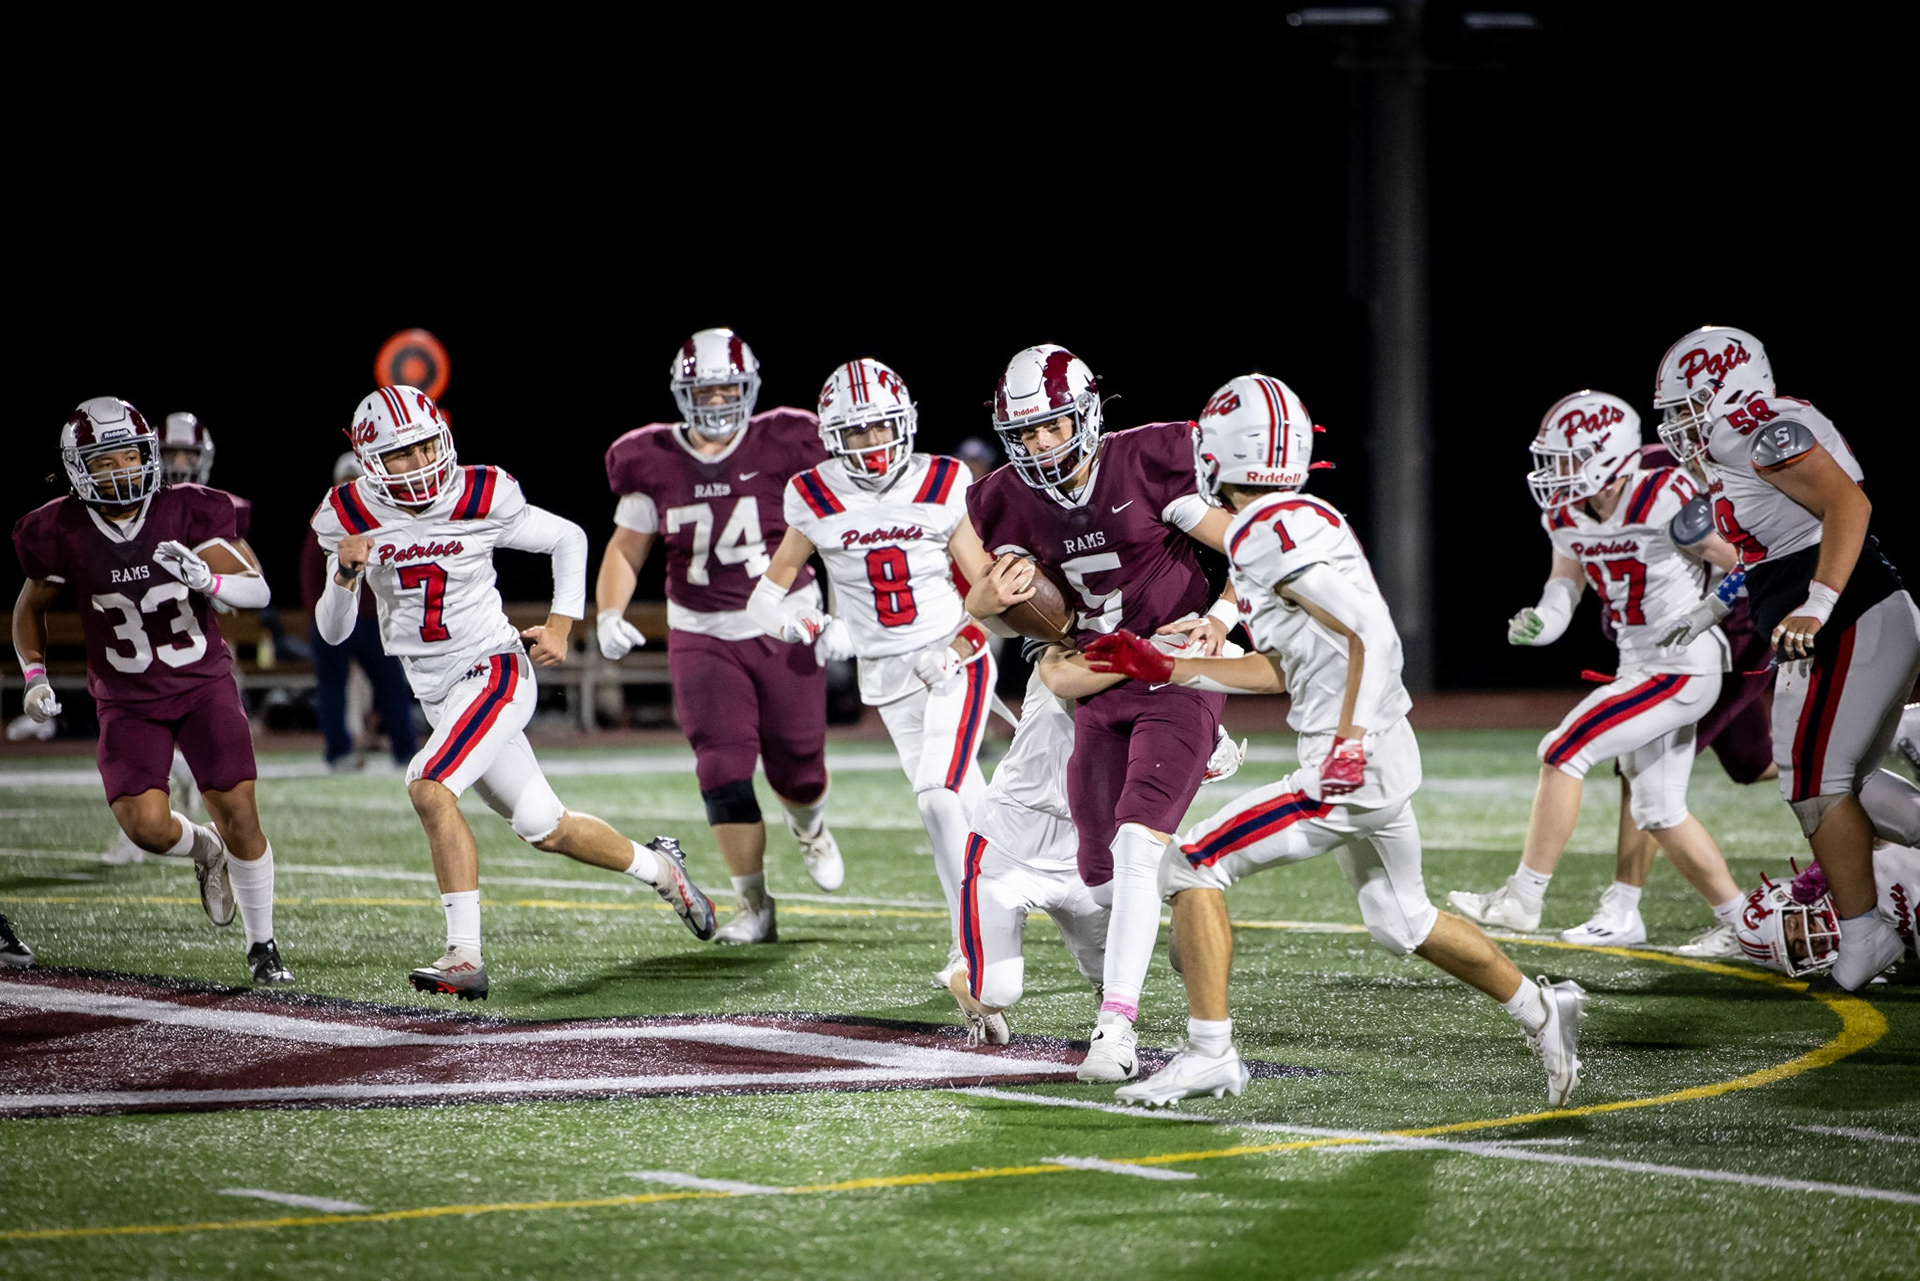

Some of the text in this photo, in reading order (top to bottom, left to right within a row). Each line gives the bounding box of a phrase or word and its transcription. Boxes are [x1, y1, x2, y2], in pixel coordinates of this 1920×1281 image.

[1678, 343, 1752, 390] Pats
[1013, 405, 1039, 417] Riddell
[1557, 404, 1625, 448] Pats
[1726, 398, 1779, 436] 58
[1246, 471, 1302, 484] Riddell
[378, 540, 464, 566] Patriots
[666, 496, 771, 586] 74
[842, 525, 924, 551] Patriots
[1063, 531, 1106, 555] RAMS
[1272, 519, 1297, 554] 1
[111, 564, 151, 584] RAMS
[864, 544, 919, 629] 8
[1060, 551, 1123, 635] 5
[395, 560, 452, 643] 7
[91, 582, 208, 674] 33
